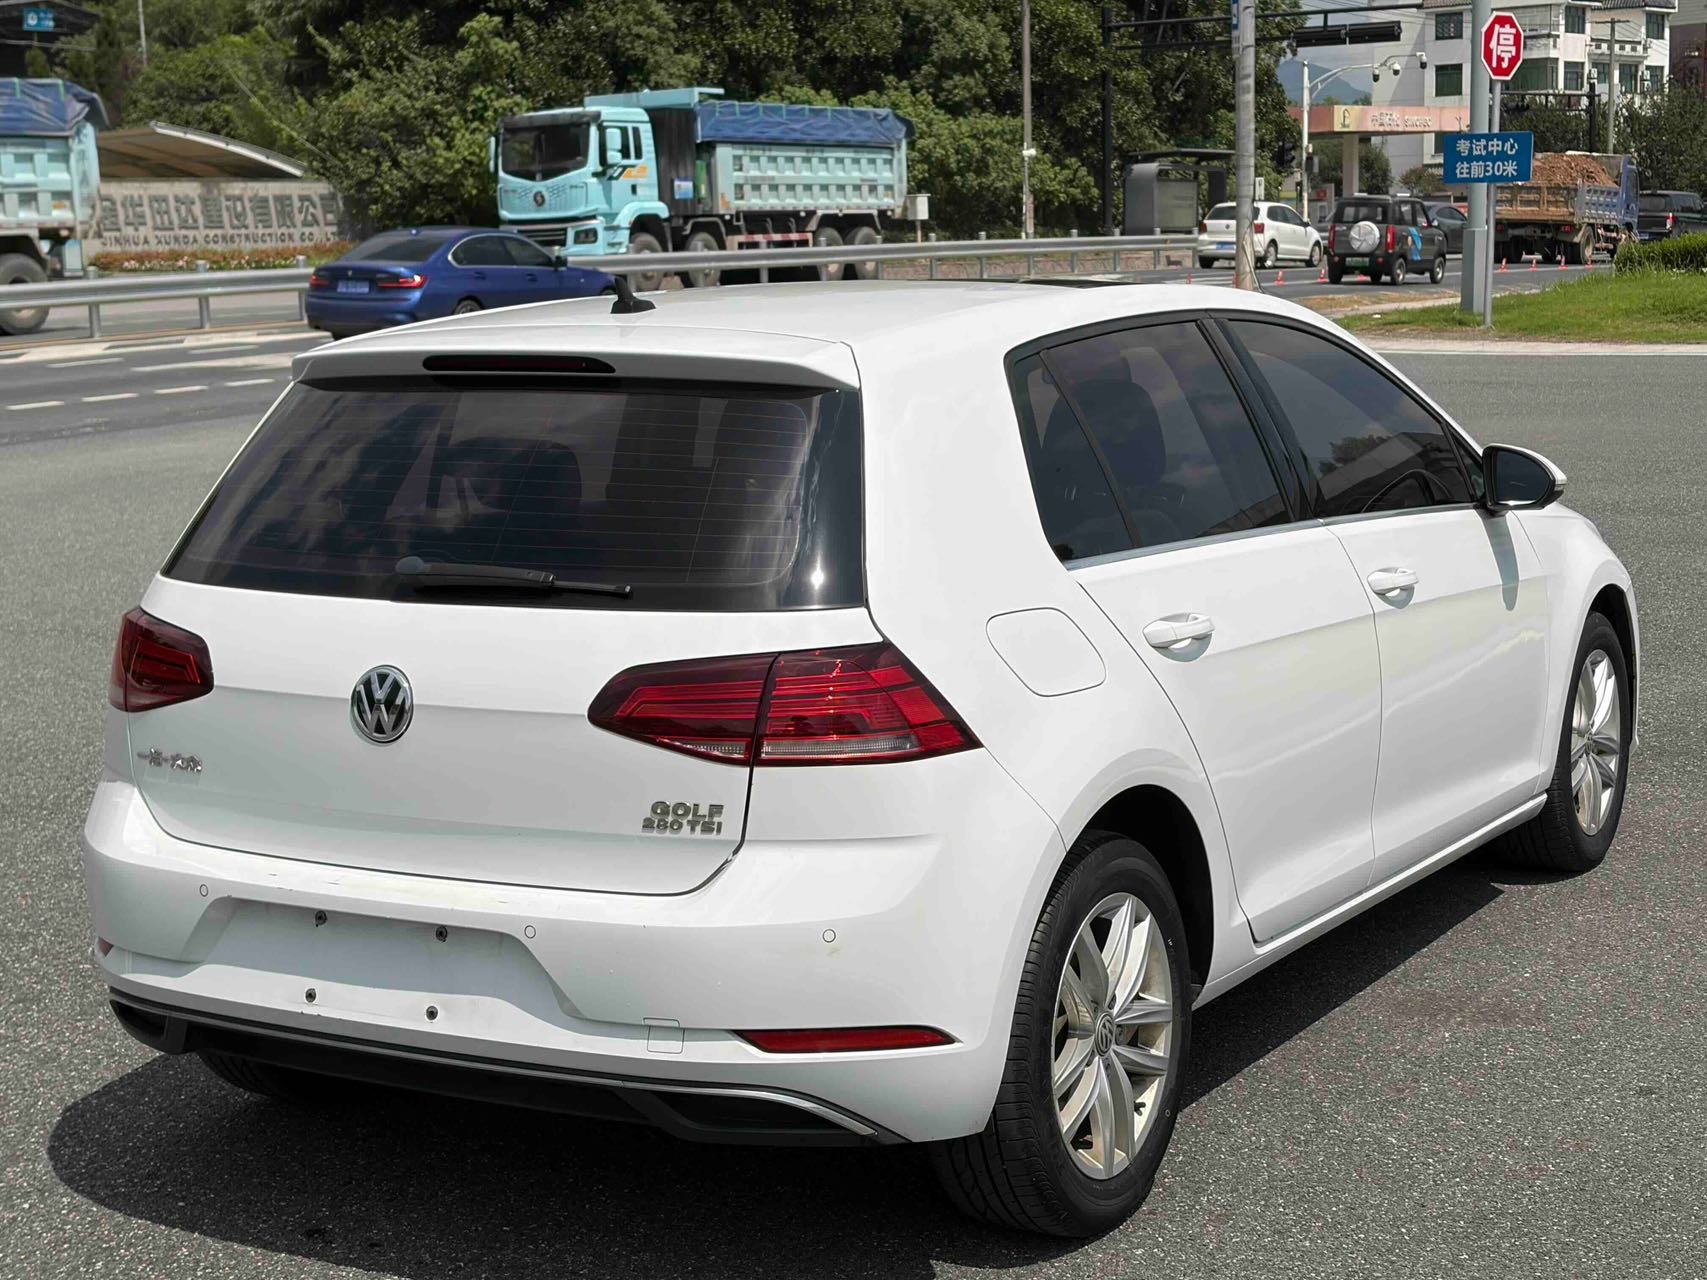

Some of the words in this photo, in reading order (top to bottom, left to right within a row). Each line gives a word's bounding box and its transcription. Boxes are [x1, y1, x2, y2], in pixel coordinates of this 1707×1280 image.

[1488, 24, 1517, 69] 停
[1456, 138, 1519, 157] 考试中心
[1455, 160, 1518, 179] 往前30米
[101, 234, 150, 247] JINHUA
[155, 234, 199, 246] XUNDA
[203, 231, 295, 245] CONSTRUCTION
[650, 801, 724, 821] GOLF
